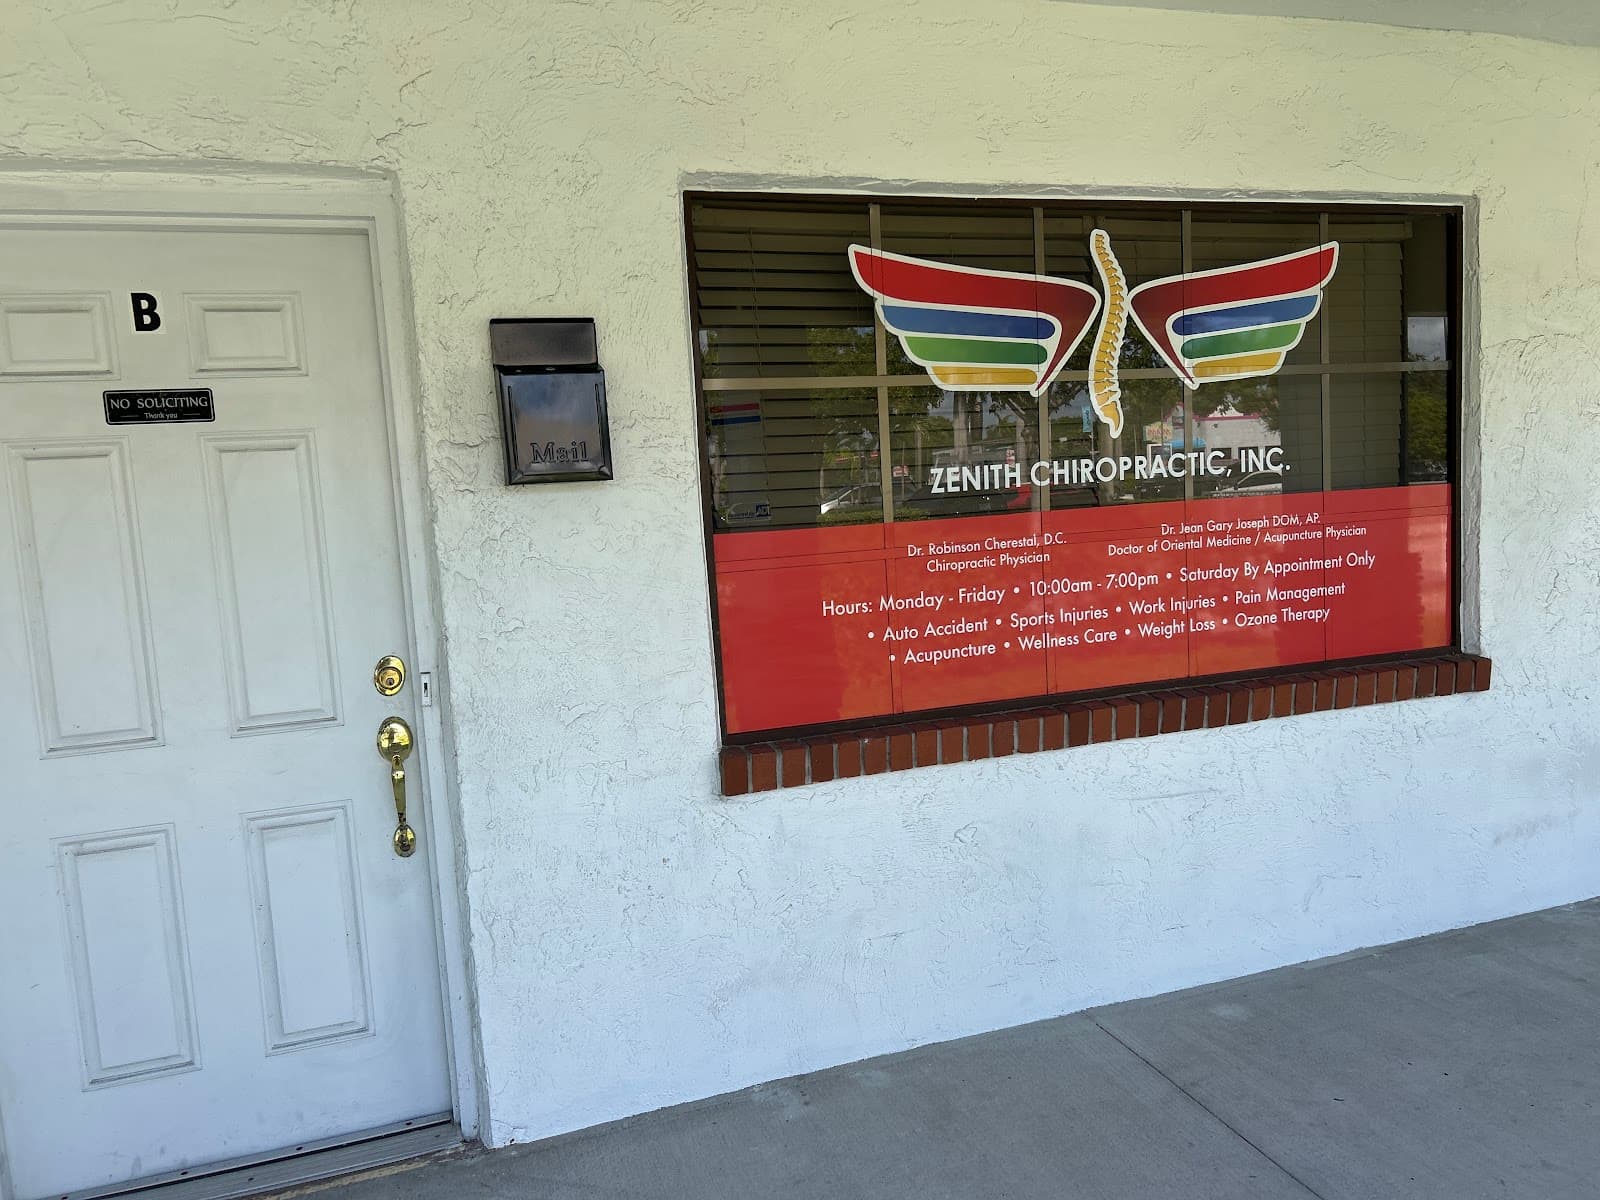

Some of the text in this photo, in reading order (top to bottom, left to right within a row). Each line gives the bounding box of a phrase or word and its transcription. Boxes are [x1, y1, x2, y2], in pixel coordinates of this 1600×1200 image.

[131, 292, 162, 332] B
[110, 396, 208, 409] NO SOLICITING
[530, 440, 589, 464] Mail
[930, 463, 1022, 494] ZENITH
[1030, 451, 1232, 487] CHIROPRACTIC,
[1240, 447, 1291, 473] INC.
[1161, 512, 1320, 536] Dr. Jean Gary Joseph DOM, AP.
[908, 532, 1067, 557] Dr. Robinson Cherestal, D.C.
[1108, 542, 1143, 556] Doctor
[1147, 541, 1158, 552] of
[1160, 536, 1202, 551] Oriental
[1206, 534, 1252, 548] Medicine
[1264, 528, 1322, 544] Acupuncture
[1326, 525, 1366, 540] Physician
[926, 552, 1050, 573] Chiropractic Physician
[822, 600, 872, 617] Hours:
[880, 591, 944, 612] Monday
[958, 584, 1006, 604] Friday
[1029, 579, 1092, 597] 10:00am
[1106, 572, 1159, 590] 7:00pm
[1180, 564, 1239, 582] Saturday
[1244, 562, 1260, 577] By
[1264, 555, 1342, 576] Appointment
[1346, 550, 1376, 568] Only
[883, 582, 1346, 642] Auto Accident Sports Injuries Work Injuries Pain Management
[904, 607, 1330, 665] Acupuncture Wellness Care Weight Loss Ozone Therapy
